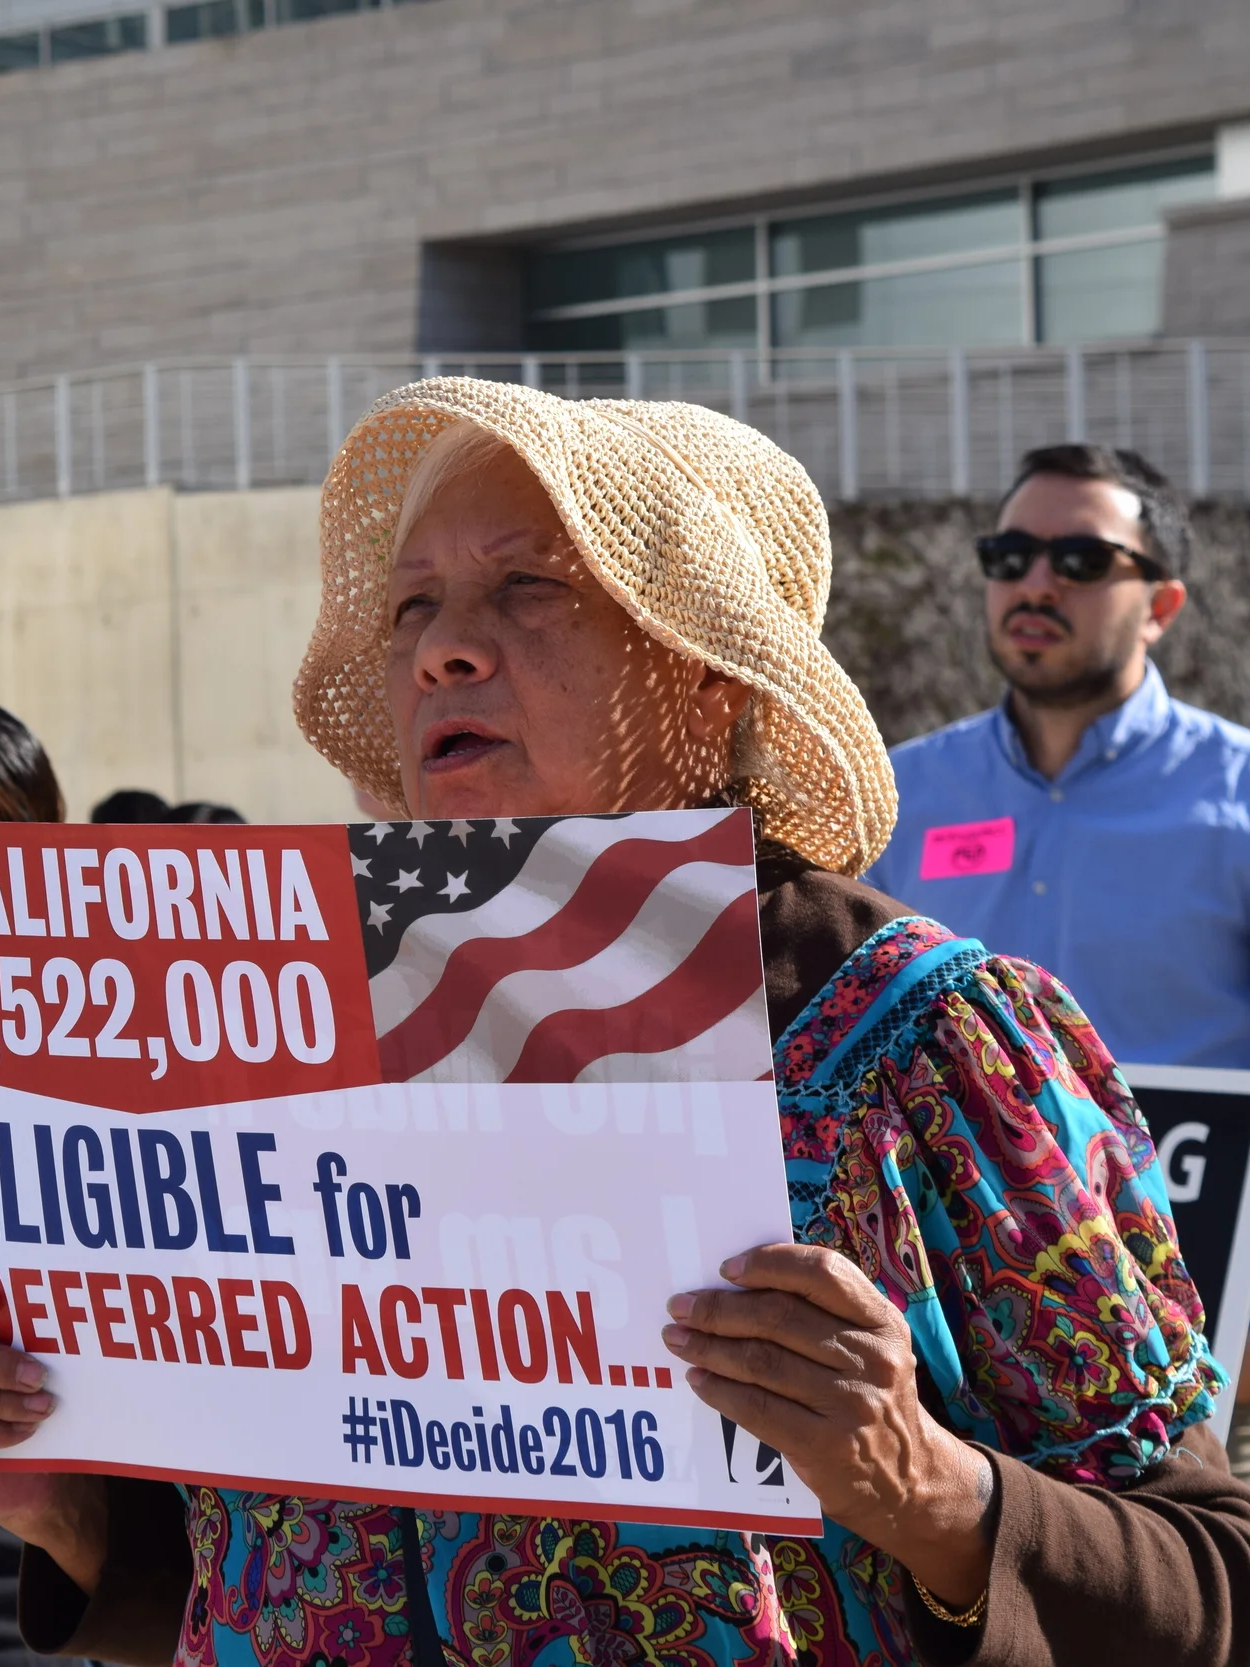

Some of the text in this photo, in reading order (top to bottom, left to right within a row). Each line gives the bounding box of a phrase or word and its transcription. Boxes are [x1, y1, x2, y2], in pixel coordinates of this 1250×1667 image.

[313, 1151, 421, 1260] for
[341, 1283, 673, 1389] ACTION...
[342, 1395, 664, 1482] #iDecide2016
